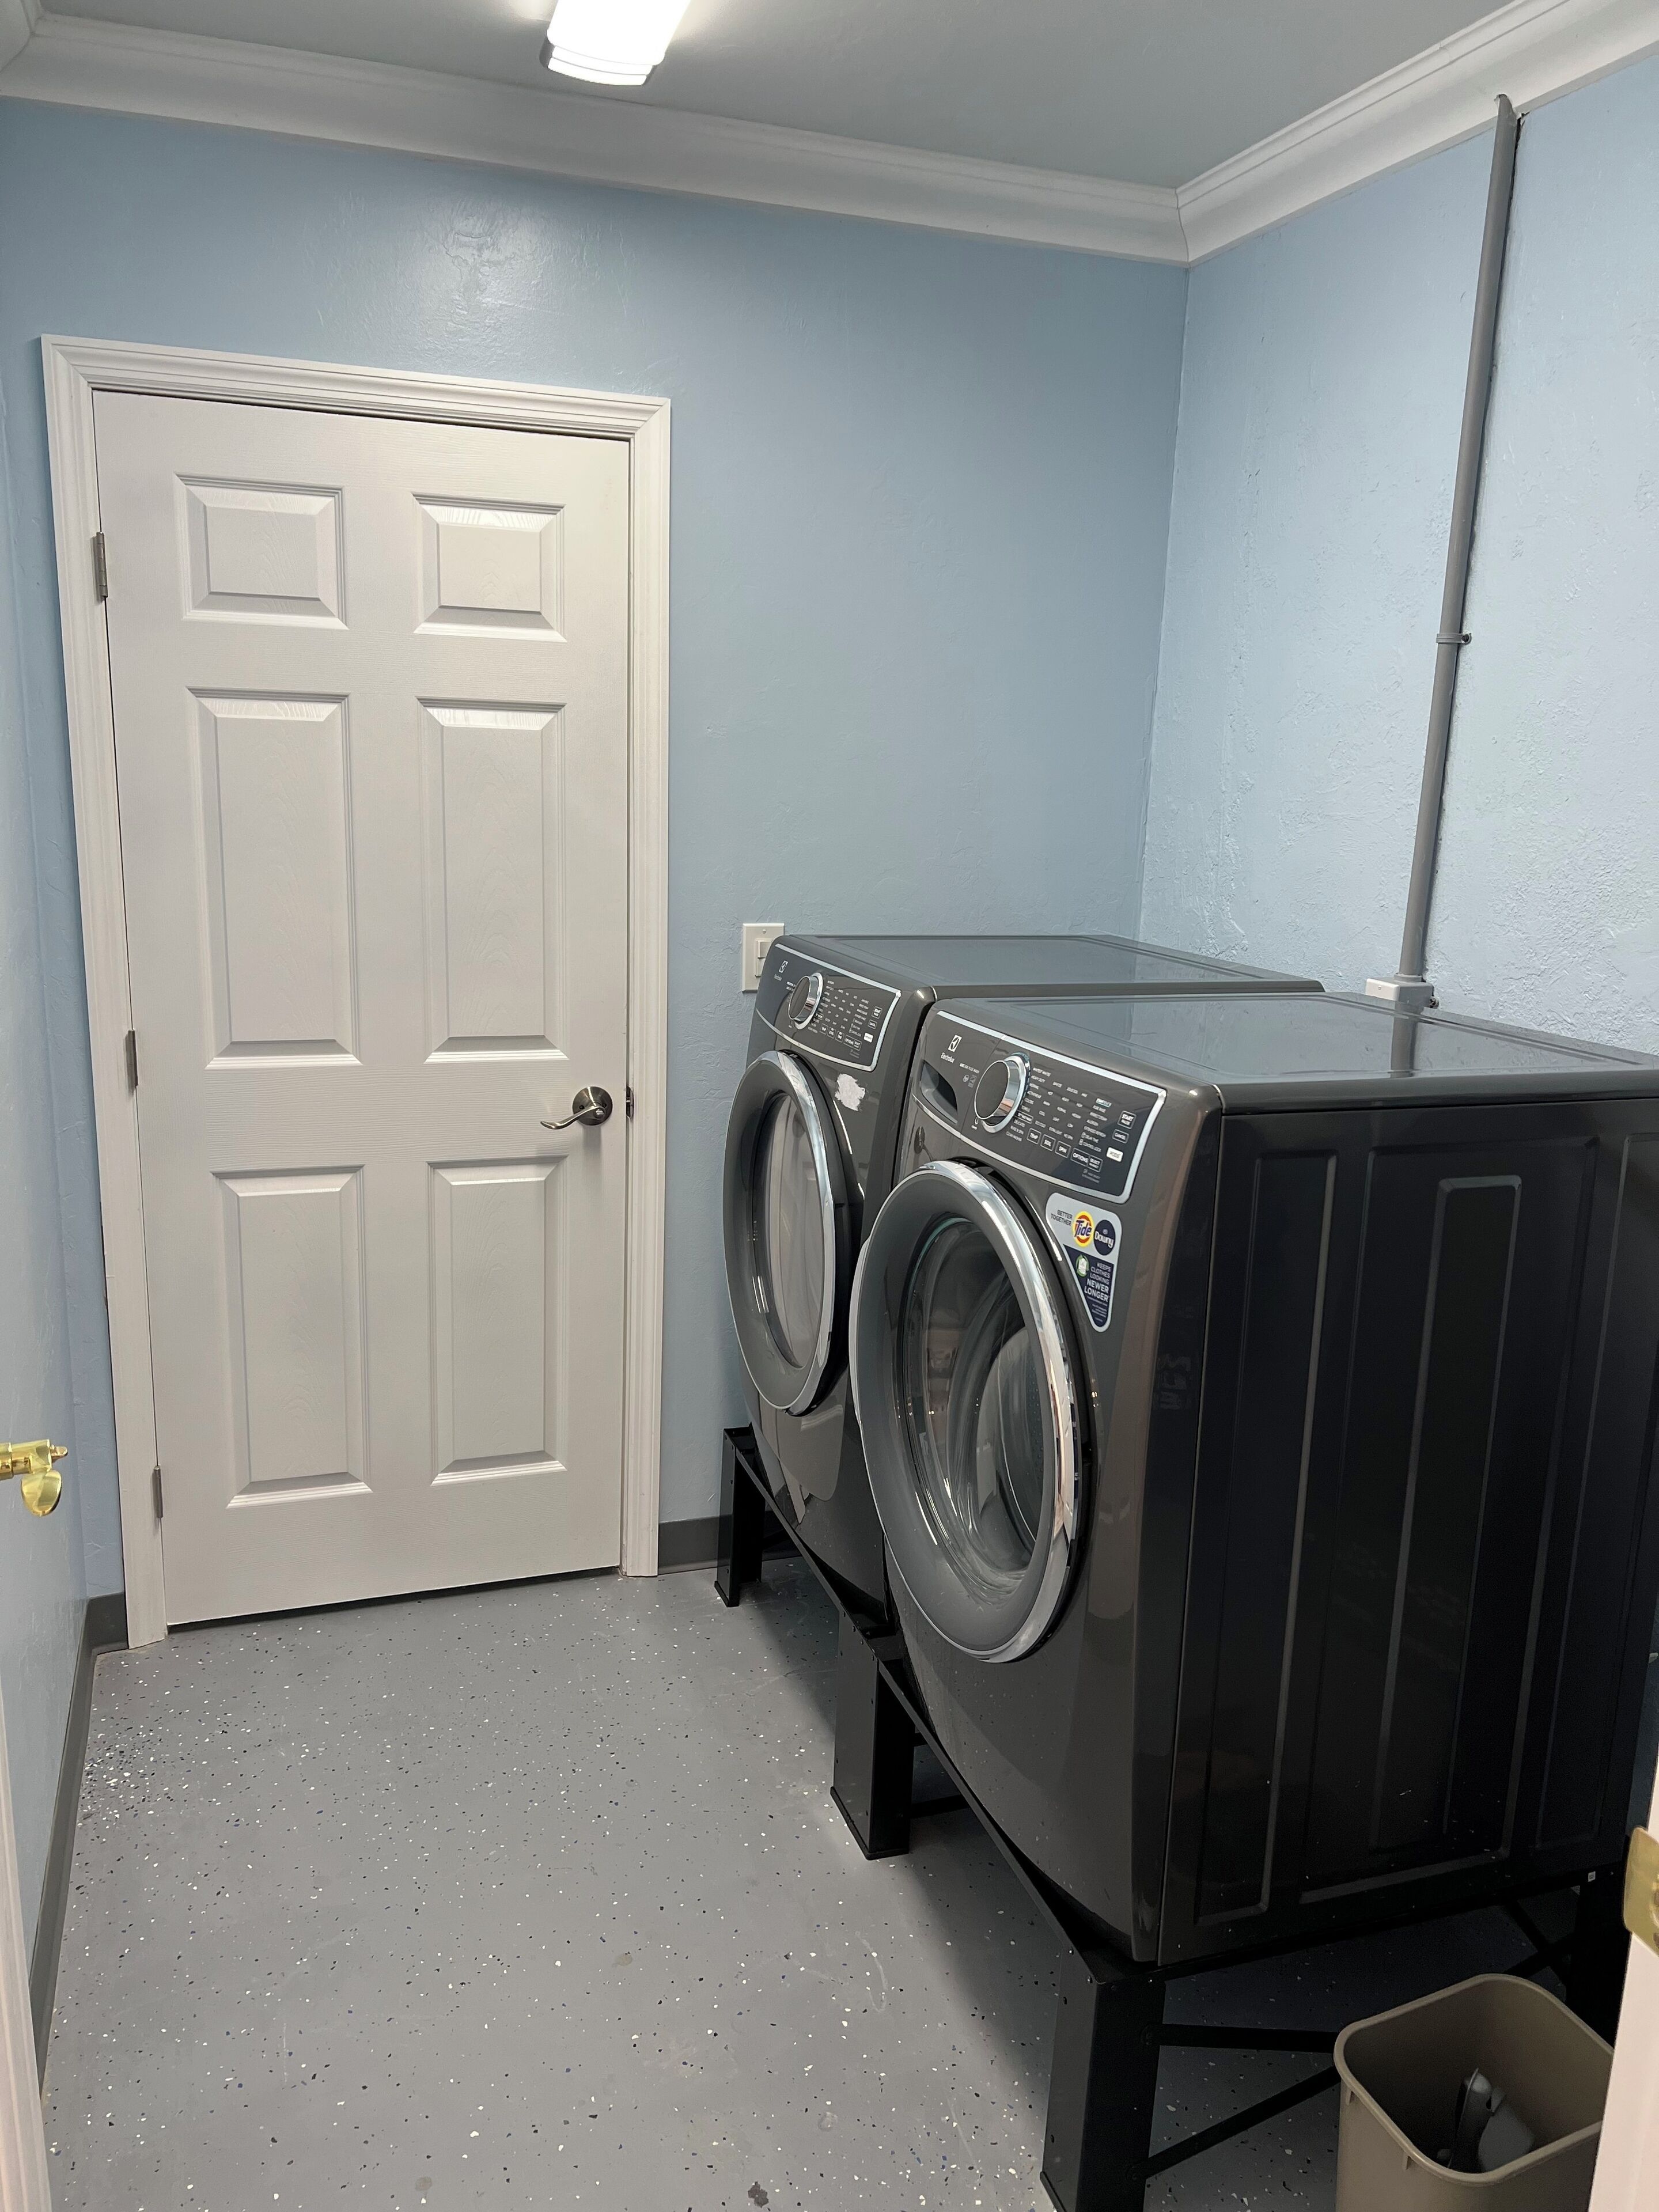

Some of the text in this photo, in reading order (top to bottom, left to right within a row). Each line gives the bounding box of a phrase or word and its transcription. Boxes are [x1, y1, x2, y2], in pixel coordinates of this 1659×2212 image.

[1122, 1113, 1134, 1122] START
[1073, 1152, 1089, 1163] OPTIONS
[1051, 1213, 1071, 1226] TOGETHER
[1057, 1209, 1073, 1219] BETTER
[1074, 1219, 1092, 1237] Tide
[1094, 1230, 1114, 1248] Downy
[1090, 1266, 1111, 1279] CLOTHES
[1097, 1262, 1111, 1272] KEEPS
[1090, 1272, 1109, 1285] LOOKING
[1086, 1278, 1109, 1294] NEWER
